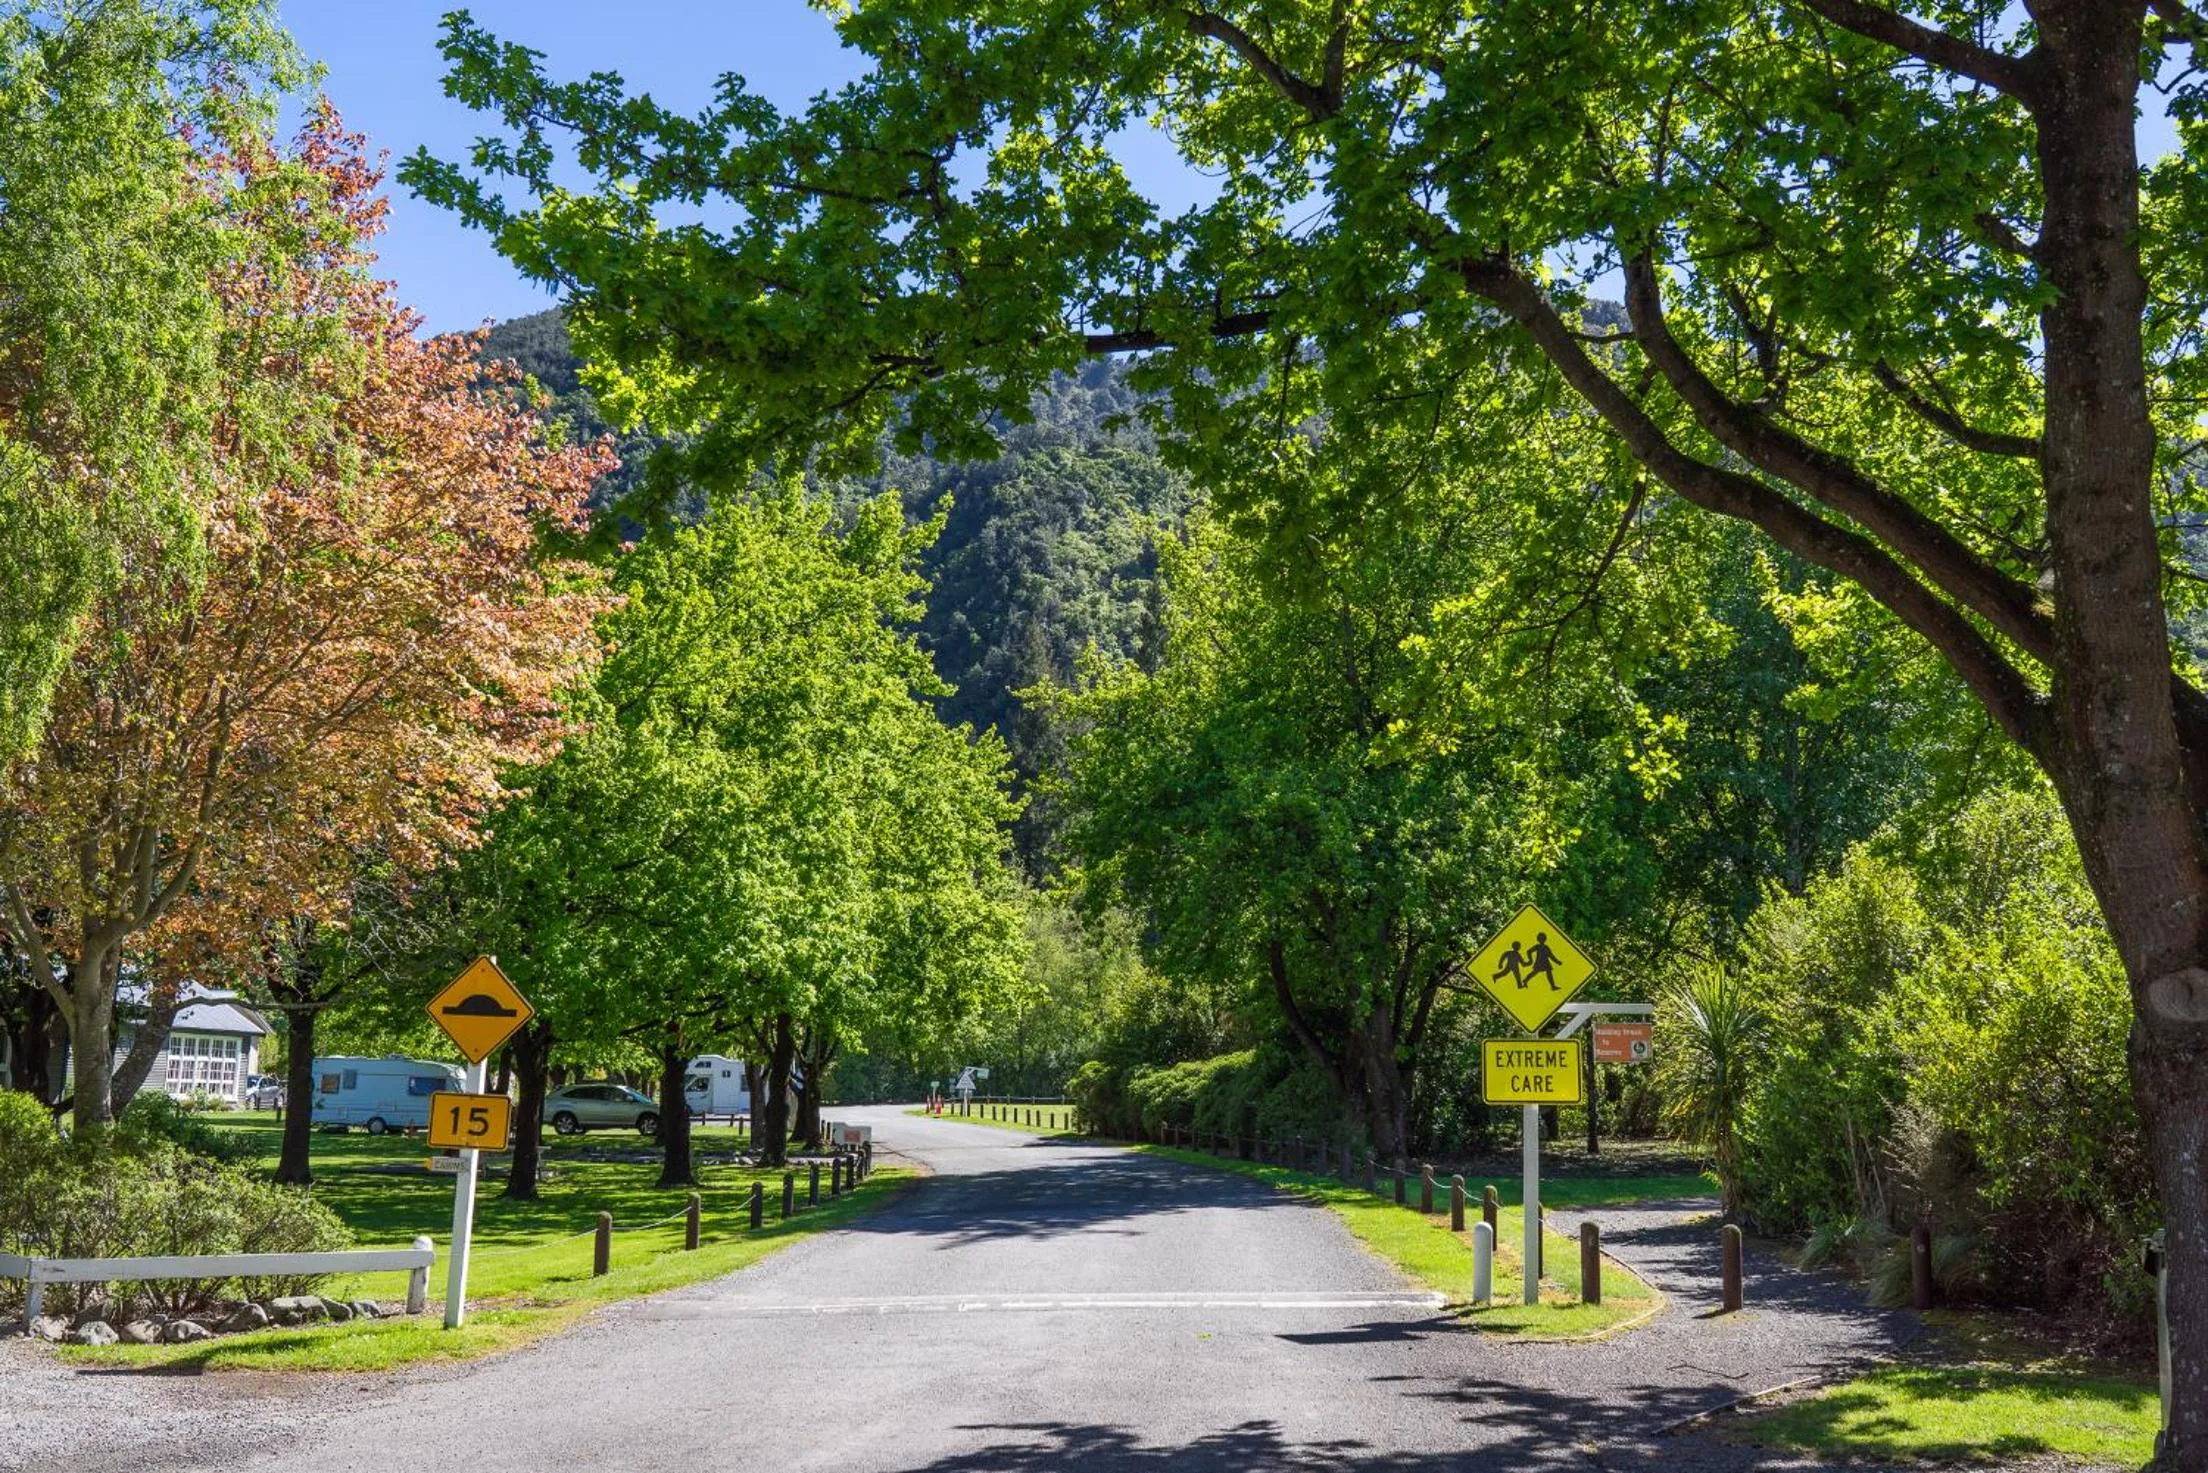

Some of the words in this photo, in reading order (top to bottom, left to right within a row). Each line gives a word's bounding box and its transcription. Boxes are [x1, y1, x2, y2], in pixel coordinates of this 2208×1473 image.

[1496, 1050, 1567, 1068] EXTREME
[1511, 1075, 1554, 1093] CARE
[450, 1106, 489, 1136] 15
